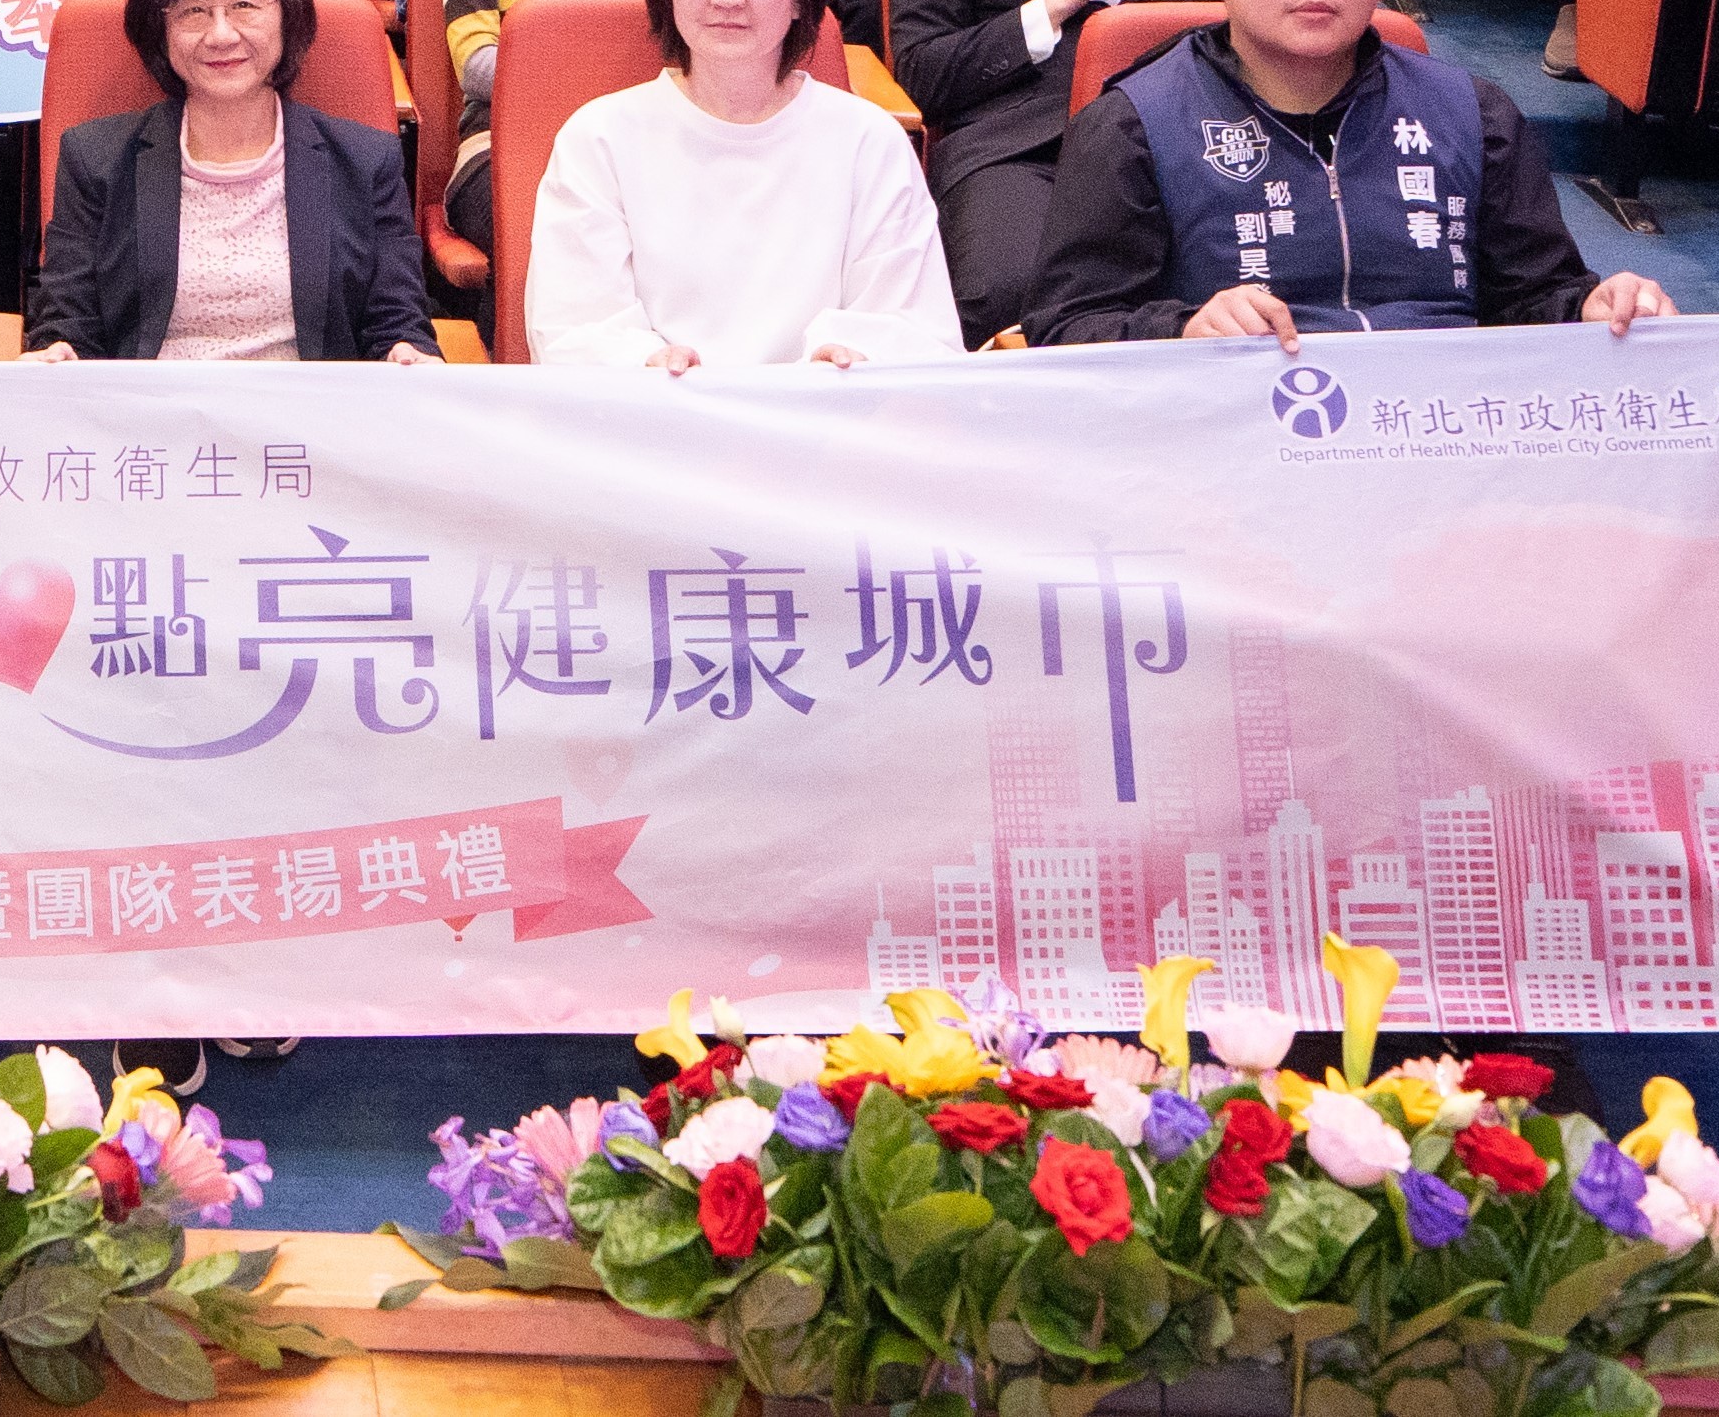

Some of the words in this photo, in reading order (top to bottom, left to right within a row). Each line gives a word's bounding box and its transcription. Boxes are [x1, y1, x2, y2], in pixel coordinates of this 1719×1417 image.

[1221, 127, 1248, 144] GO
[1223, 148, 1255, 165] CHUN
[1263, 180, 1296, 237] 秘書
[1392, 117, 1442, 250] 林國春
[1234, 211, 1272, 295] 劉昊
[1280, 446, 1384, 464] Department
[1388, 442, 1406, 459] of
[1513, 438, 1563, 459] Taipei
[1568, 437, 1602, 458] City
[1605, 434, 1713, 453] Government
[39, 522, 1189, 805] 點亮健康城市
